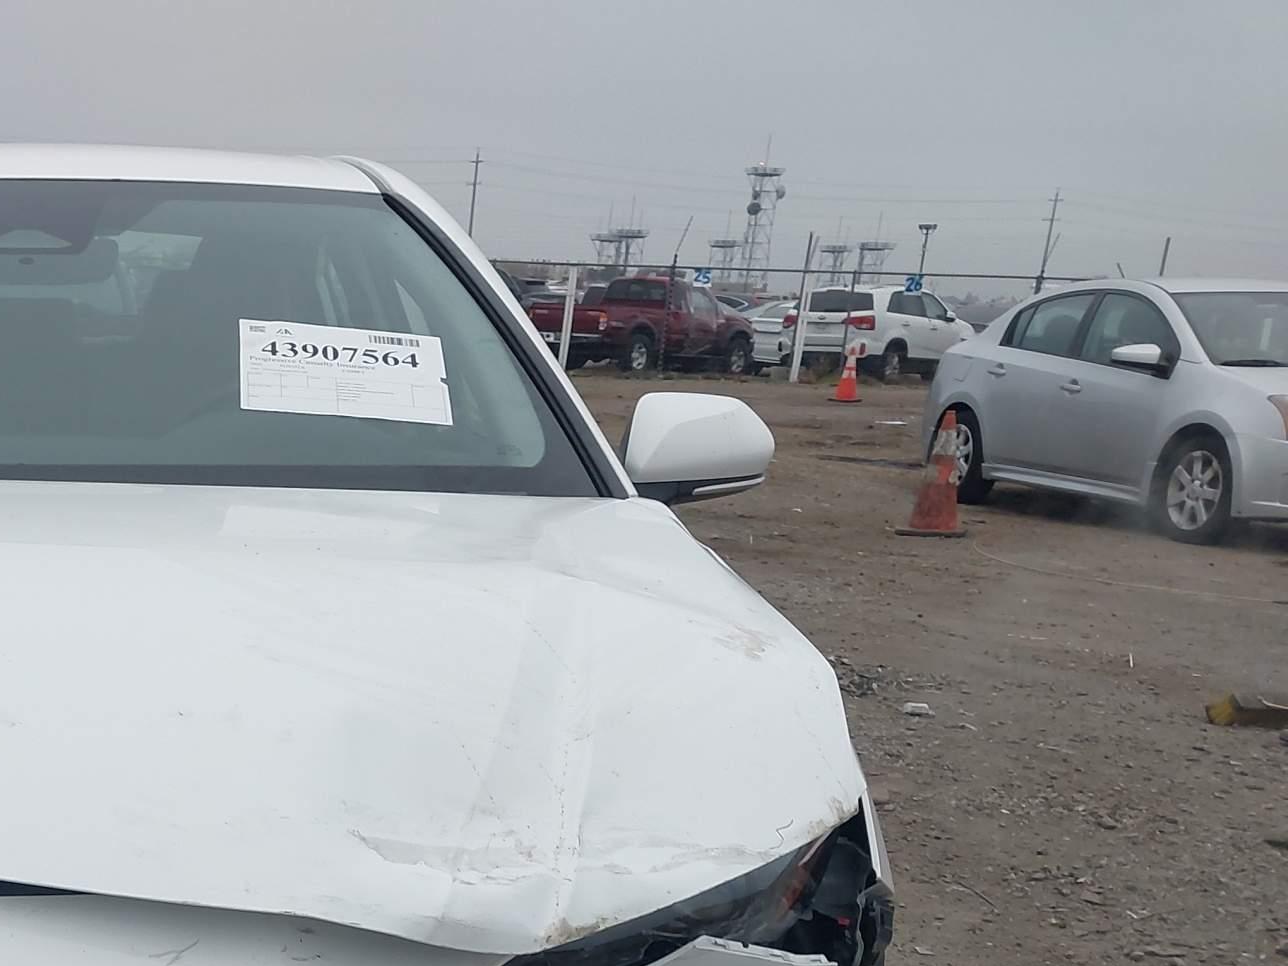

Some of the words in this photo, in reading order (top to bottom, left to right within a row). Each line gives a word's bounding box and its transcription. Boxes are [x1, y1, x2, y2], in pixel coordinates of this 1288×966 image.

[694, 269, 711, 284] 25
[905, 276, 923, 292] 26
[261, 340, 420, 369] 43907564
